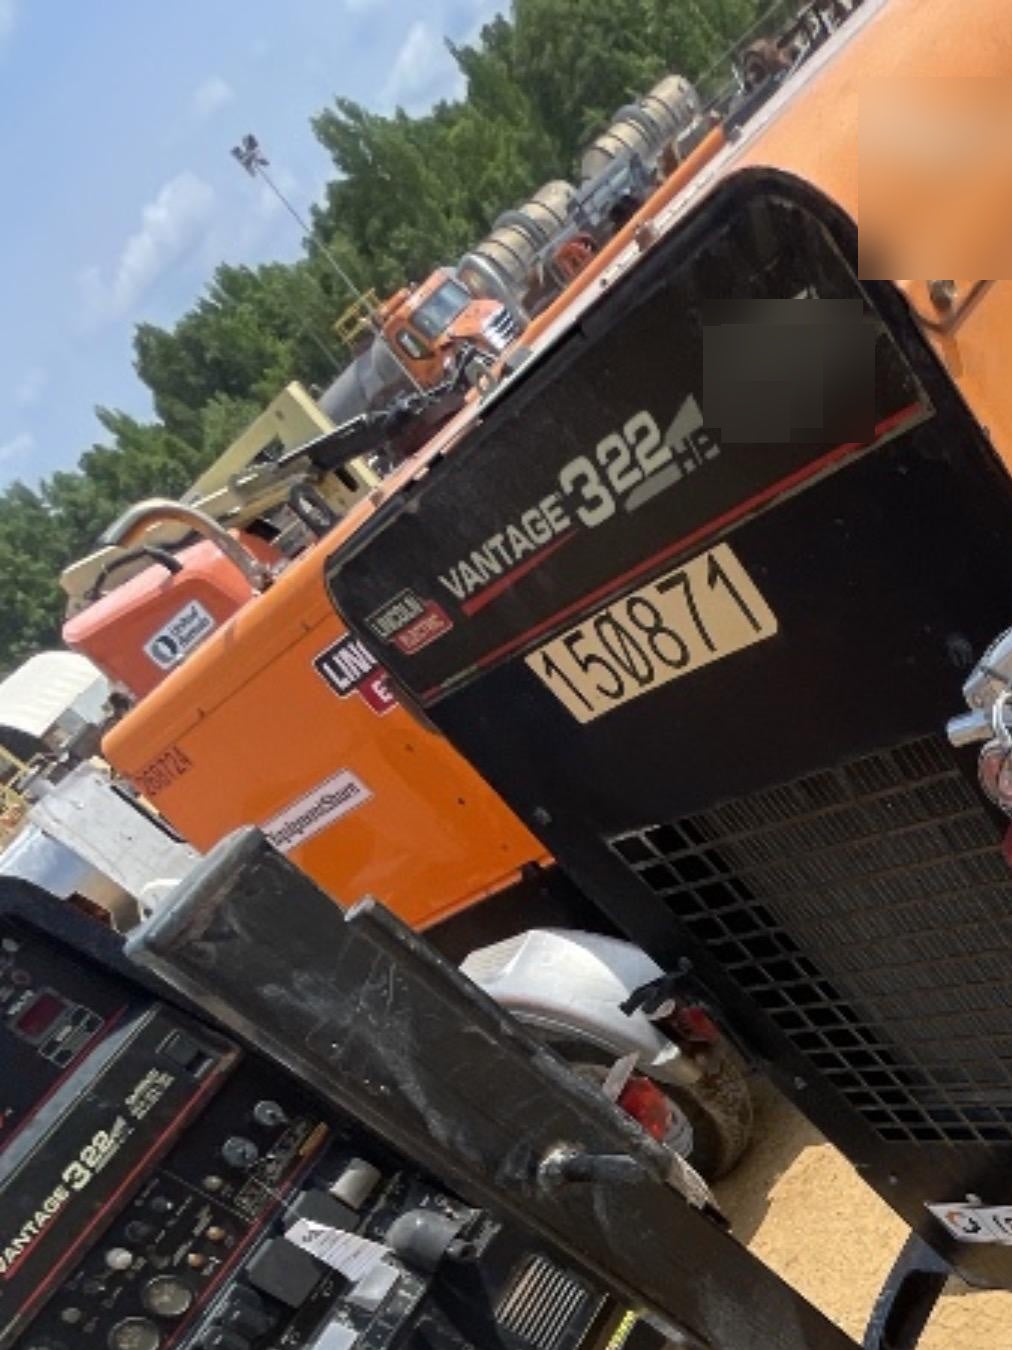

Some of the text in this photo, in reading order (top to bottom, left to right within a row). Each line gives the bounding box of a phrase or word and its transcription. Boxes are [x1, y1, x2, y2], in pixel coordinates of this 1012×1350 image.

[438, 409, 676, 600] VANTAGE 322
[540, 552, 764, 715] 150871
[62, 1129, 115, 1192] 322
